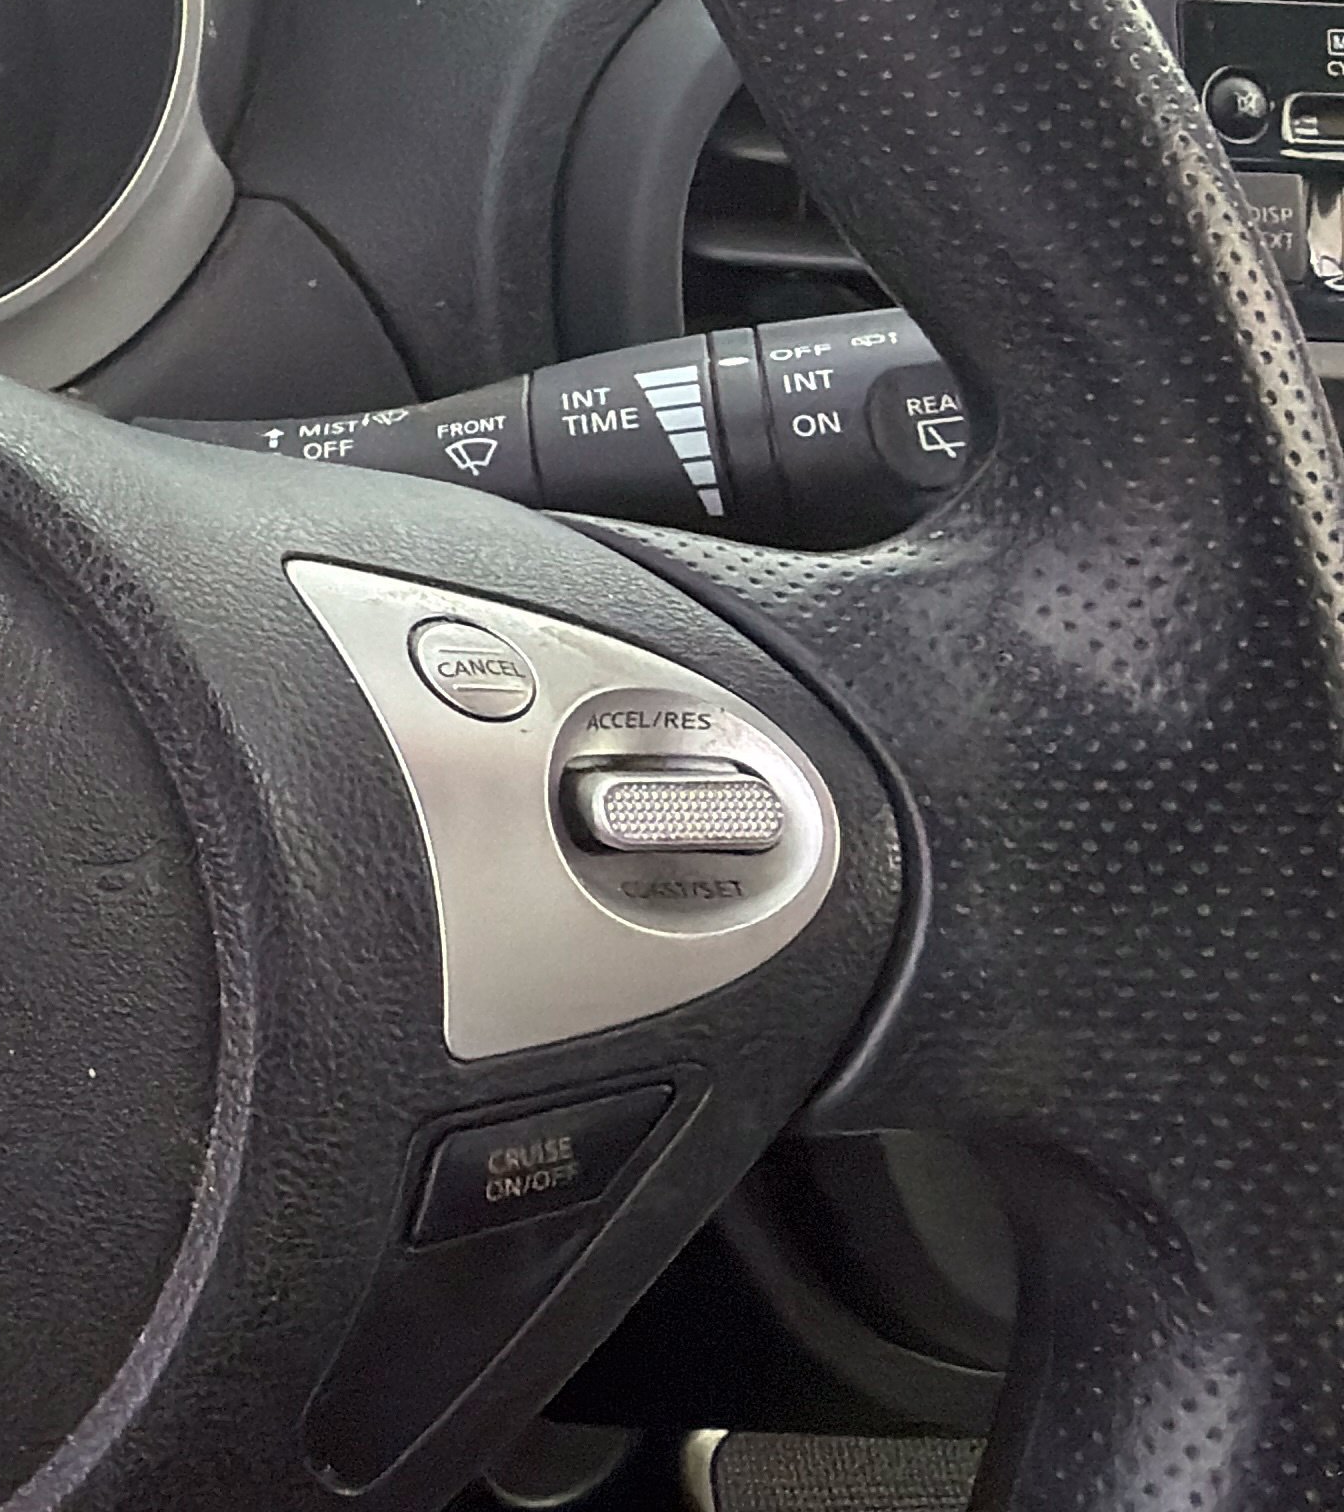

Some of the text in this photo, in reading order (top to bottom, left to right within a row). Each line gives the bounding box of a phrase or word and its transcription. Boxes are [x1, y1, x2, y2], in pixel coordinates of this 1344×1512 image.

[769, 343, 833, 362] OFF
[782, 368, 835, 394] INT
[561, 387, 611, 411] INT
[906, 392, 960, 417] REA
[298, 419, 360, 438] MIST
[436, 415, 507, 440] FRONT
[561, 407, 641, 437] TIME
[792, 411, 842, 438] ON
[302, 439, 355, 460] OFF
[437, 658, 527, 679] CANCEL
[585, 710, 713, 732] ACCEL/RES
[488, 1136, 572, 1175] CRUISE
[486, 1162, 579, 1202] ON/OFF
